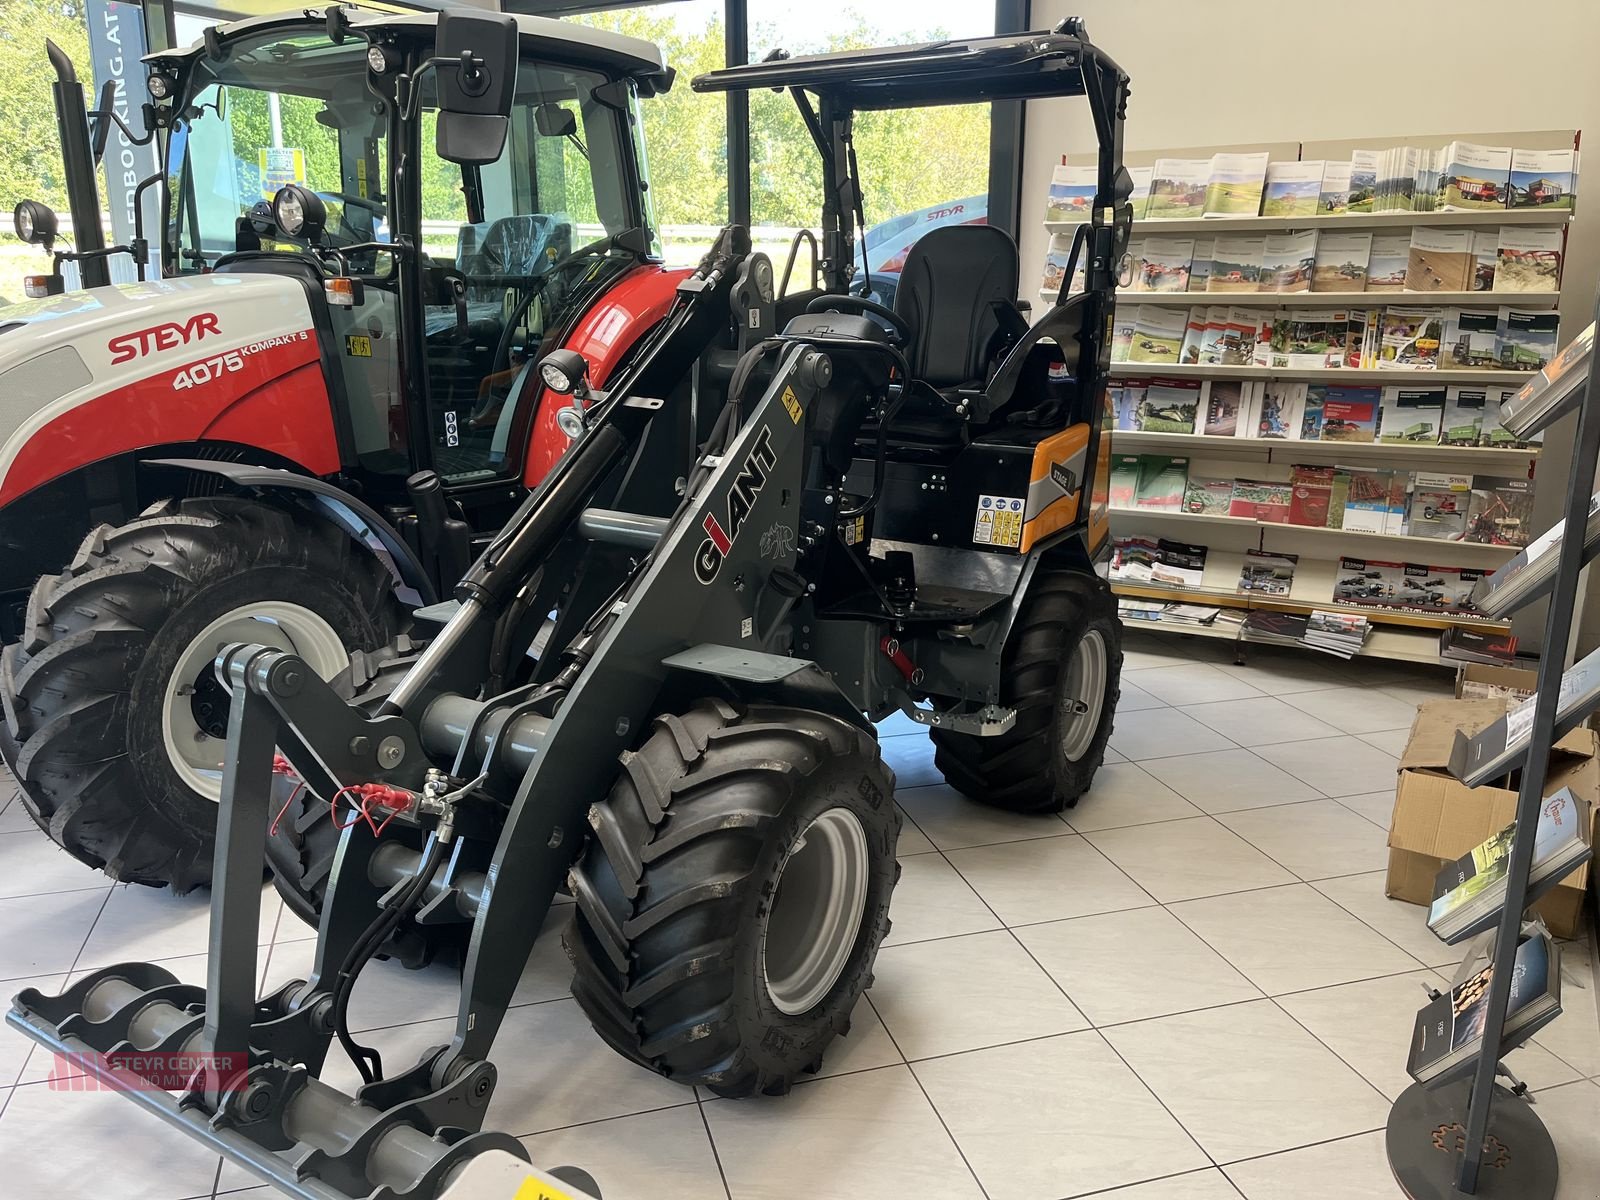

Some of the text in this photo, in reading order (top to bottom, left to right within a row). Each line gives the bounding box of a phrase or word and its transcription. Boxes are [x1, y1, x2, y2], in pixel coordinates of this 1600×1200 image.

[927, 204, 964, 221] STEYR
[108, 312, 222, 365] STEYR
[172, 331, 308, 391] 4075 KOMPAKT S
[693, 423, 778, 585] GIANT
